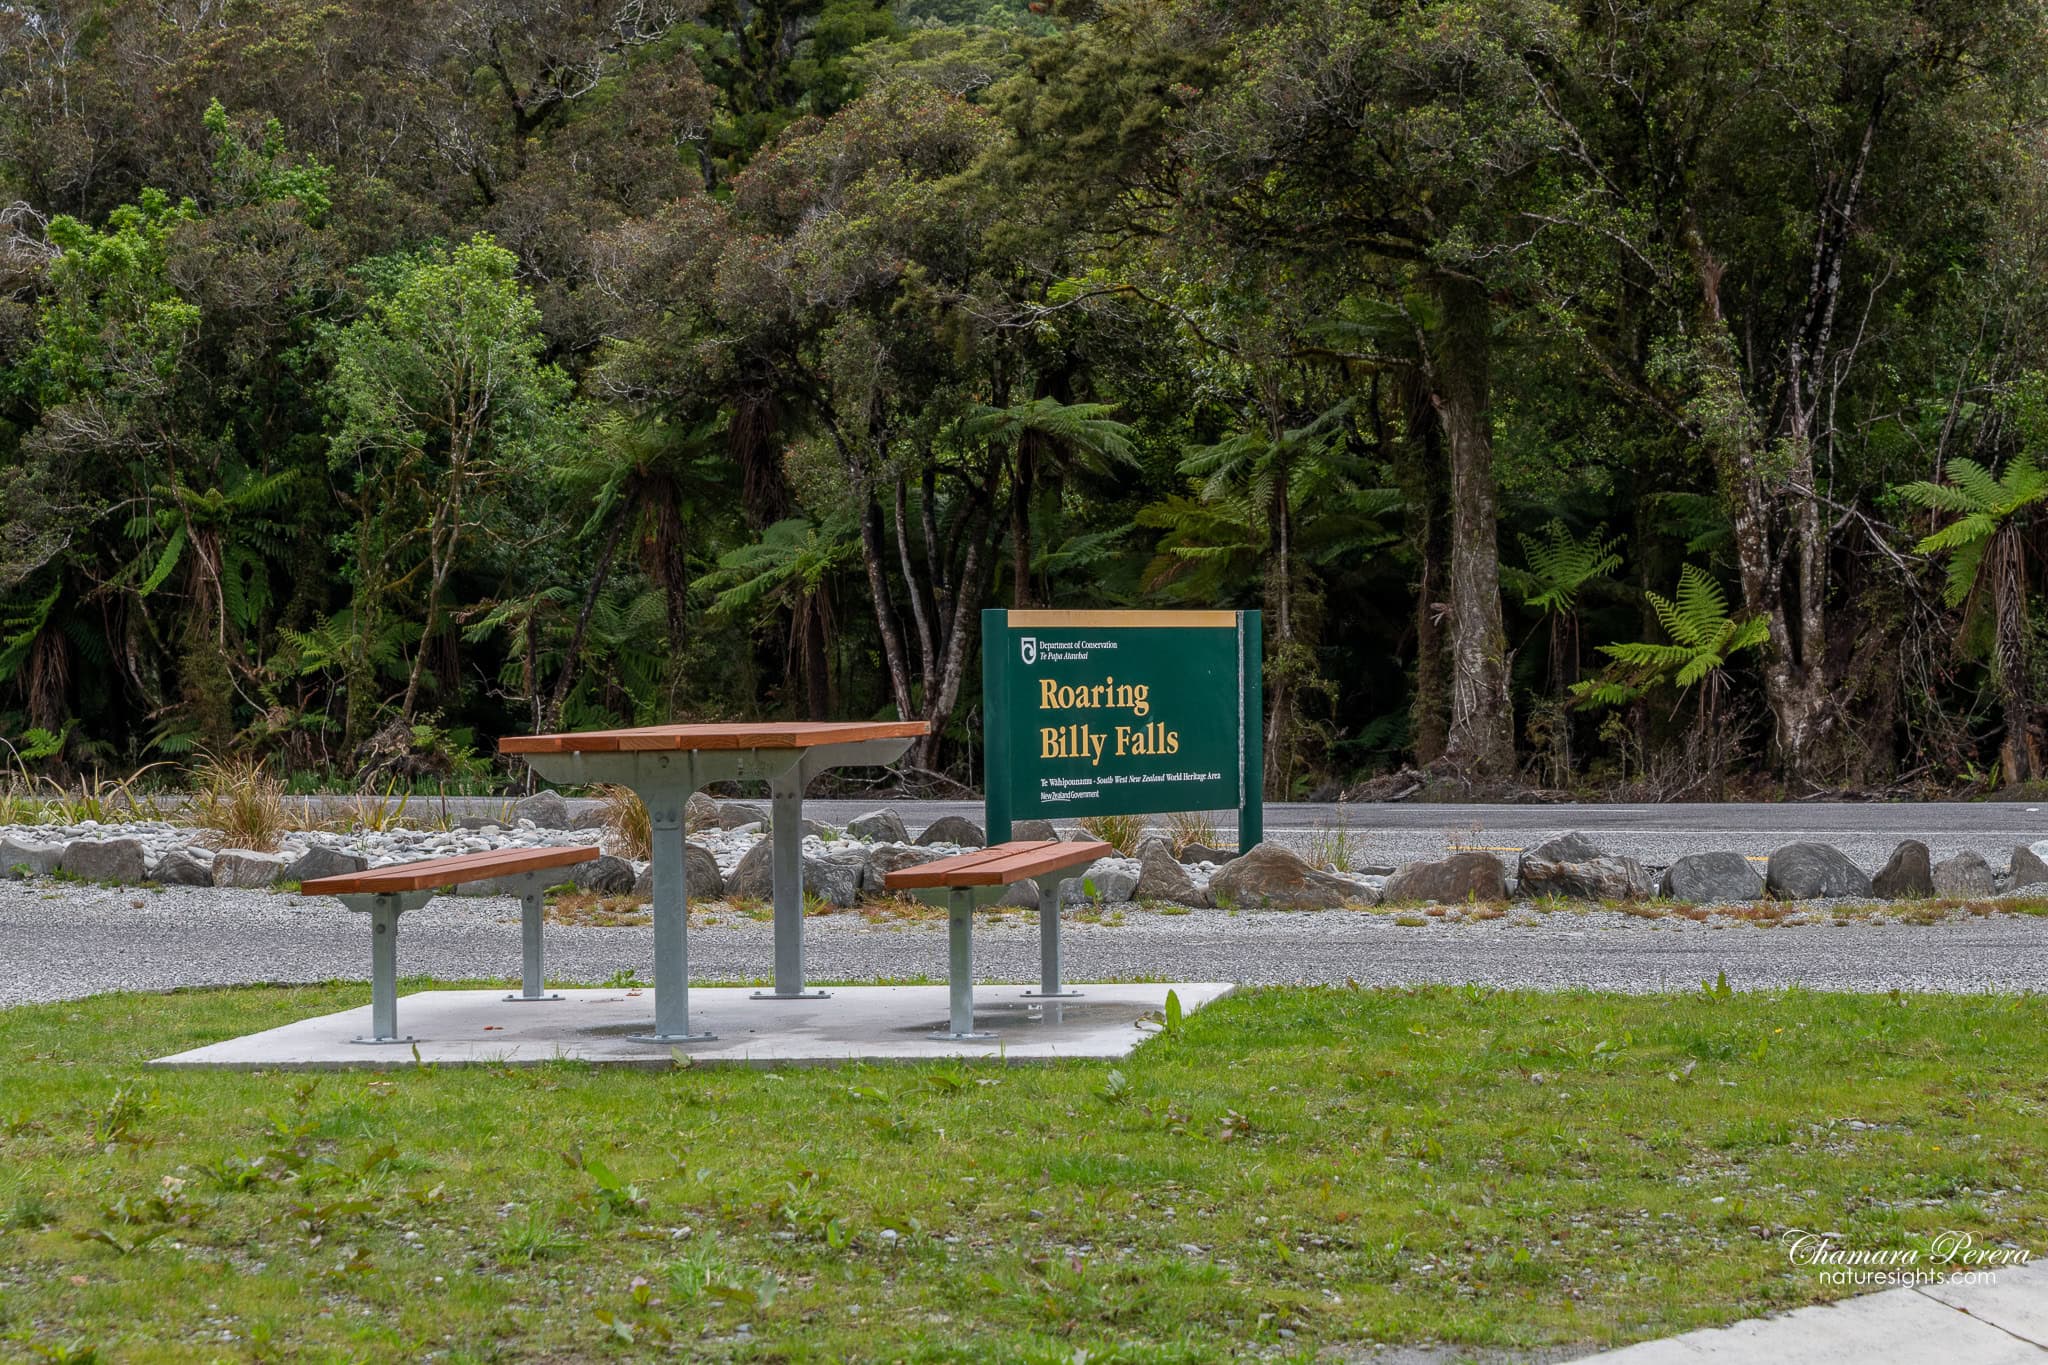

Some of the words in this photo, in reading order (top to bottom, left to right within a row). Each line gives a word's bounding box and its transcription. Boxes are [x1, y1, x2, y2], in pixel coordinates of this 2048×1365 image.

[1040, 641, 1073, 651] Department
[1074, 640, 1080, 649] of
[1081, 640, 1118, 649] Conservation
[1040, 652, 1047, 660] Te
[1047, 652, 1063, 662] Papa
[1063, 652, 1088, 660] Atawhai
[1039, 676, 1149, 716] Roaring
[1040, 723, 1107, 766] Billy
[1115, 722, 1179, 756] Falls
[1041, 778, 1048, 787] Te
[1096, 775, 1114, 785] South
[1114, 775, 1128, 784] West
[1128, 775, 1141, 783] New
[1142, 773, 1165, 783] Zealand
[1166, 772, 1182, 781] World
[1183, 771, 1207, 782] Heritage
[1207, 771, 1221, 780] Area
[1041, 791, 1052, 800] New
[1052, 790, 1071, 800] Zealand
[1071, 789, 1100, 799] Government
